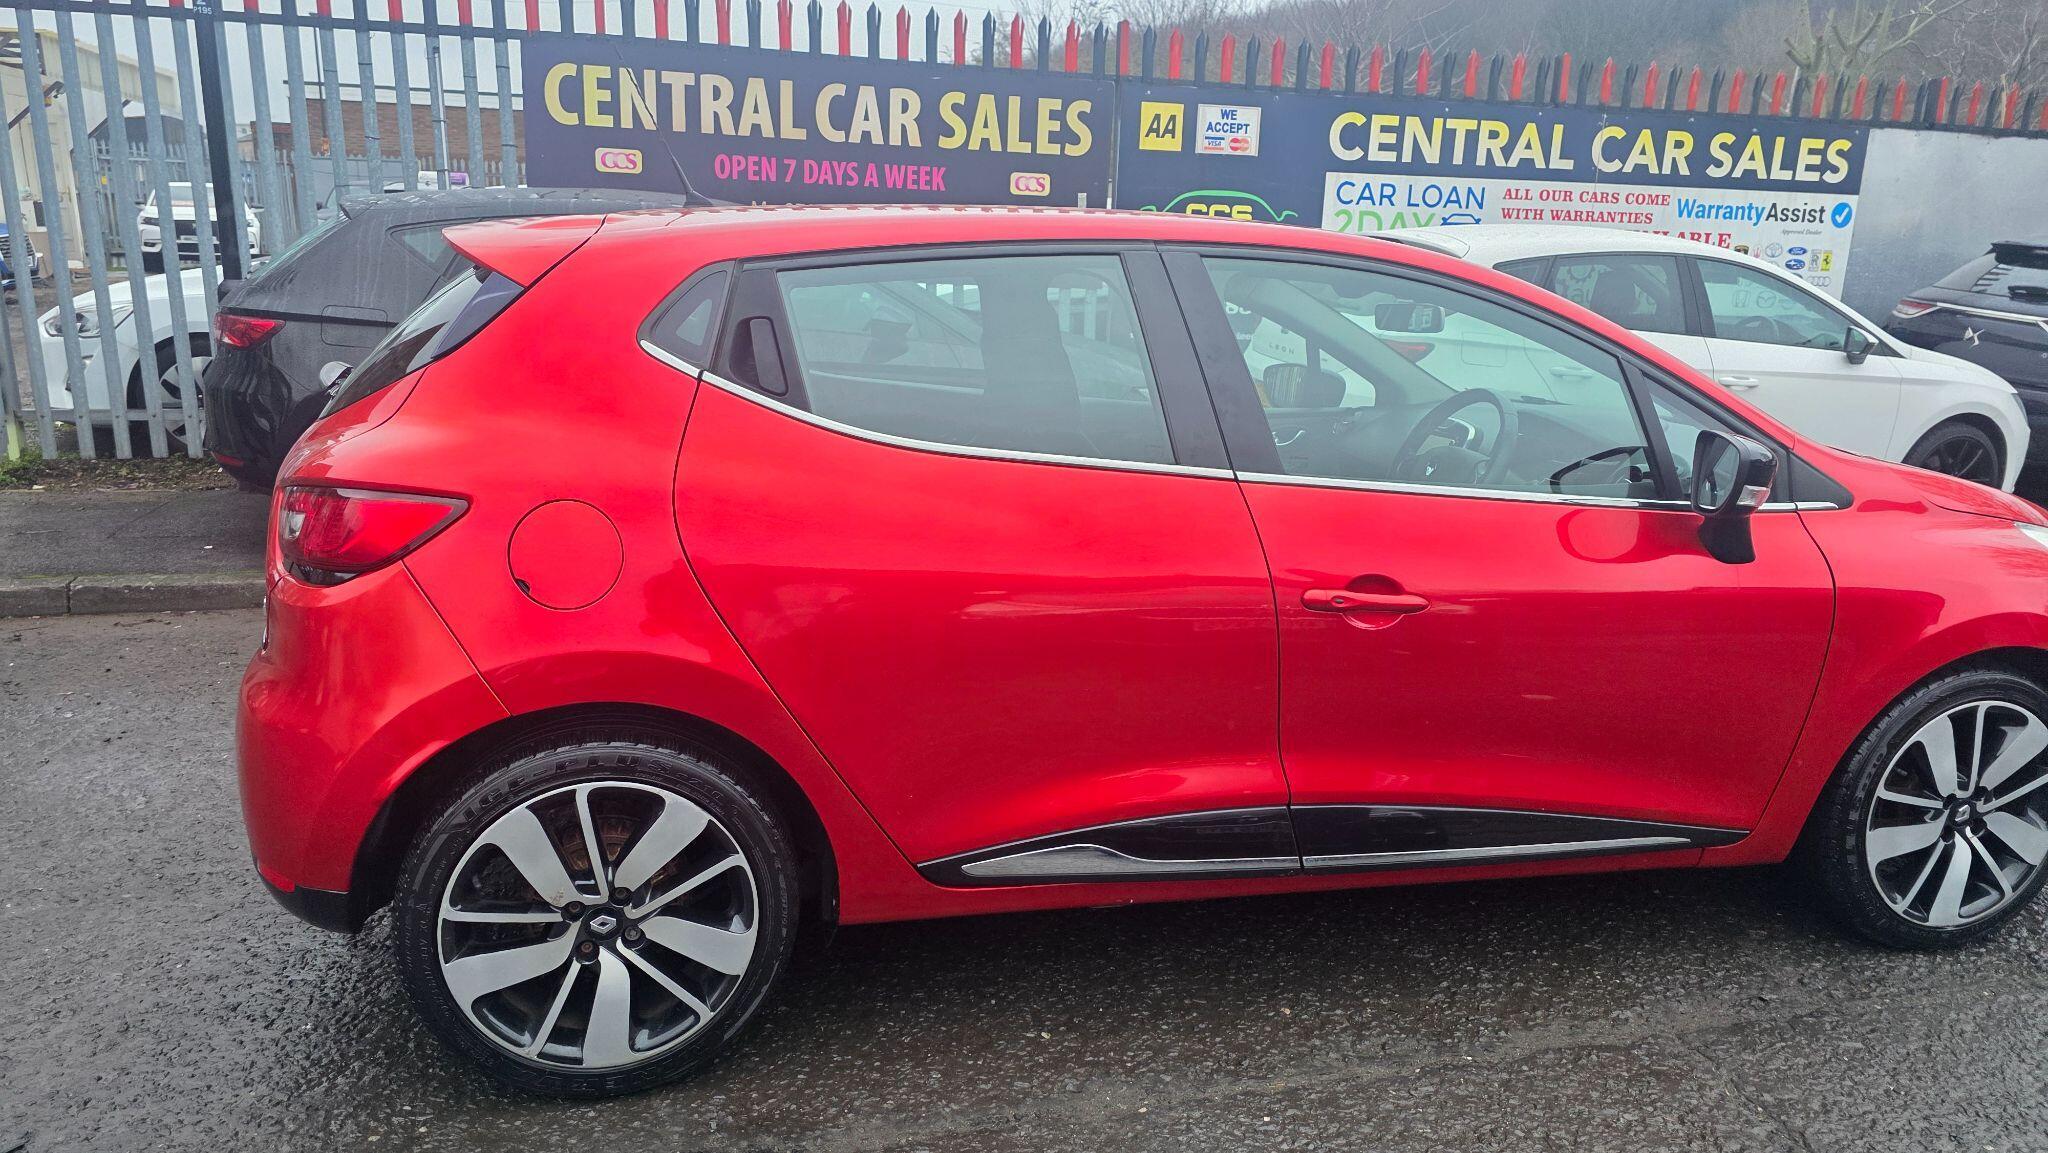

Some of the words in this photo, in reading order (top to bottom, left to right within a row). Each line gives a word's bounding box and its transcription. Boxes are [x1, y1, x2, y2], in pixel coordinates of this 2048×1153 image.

[544, 62, 806, 141] CENTRAL
[815, 82, 922, 147] CAR
[937, 91, 1092, 157] SALES
[1220, 108, 1238, 121] WE
[1145, 113, 1177, 139] AA
[1205, 122, 1250, 135] ACCEPT
[1329, 112, 1574, 170] CENTRAL
[1591, 126, 1694, 176] CAR
[1705, 132, 1852, 184] SALES
[714, 153, 777, 182] OPEN
[783, 159, 796, 183] 7
[803, 159, 859, 187] DAYS
[864, 163, 879, 188] A
[884, 164, 946, 191] WEEK
[1336, 180, 1397, 207] CAR
[1407, 184, 1486, 210] LOAN
[1502, 188, 1533, 201] ALL
[1539, 189, 1574, 202] OUR
[1579, 191, 1620, 204] CARS
[1625, 193, 1671, 206] COME
[1501, 207, 1545, 221] WITH
[1550, 209, 1653, 225] WARRANTIES
